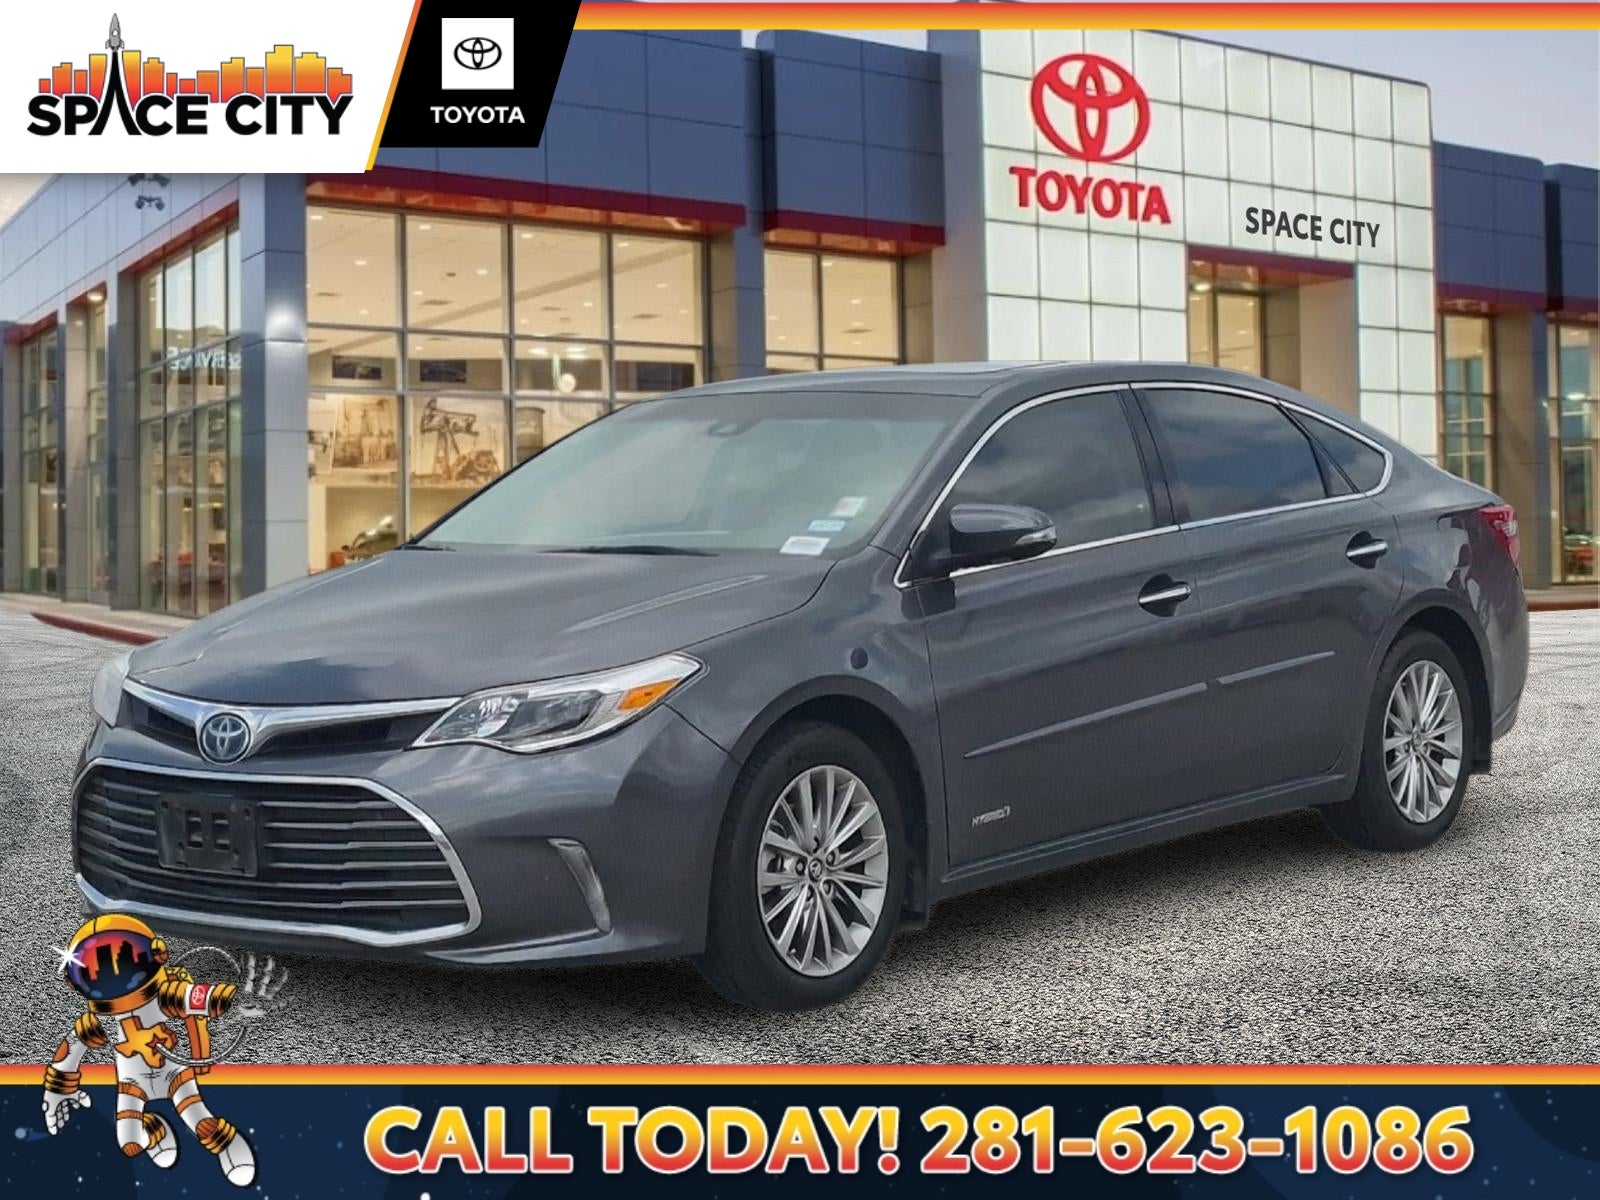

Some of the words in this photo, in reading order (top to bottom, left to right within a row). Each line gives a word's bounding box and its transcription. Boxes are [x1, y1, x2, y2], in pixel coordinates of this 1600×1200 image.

[1010, 167, 1171, 224] TOYOTA
[1245, 207, 1322, 241] SPACE
[1329, 218, 1380, 247] CITY
